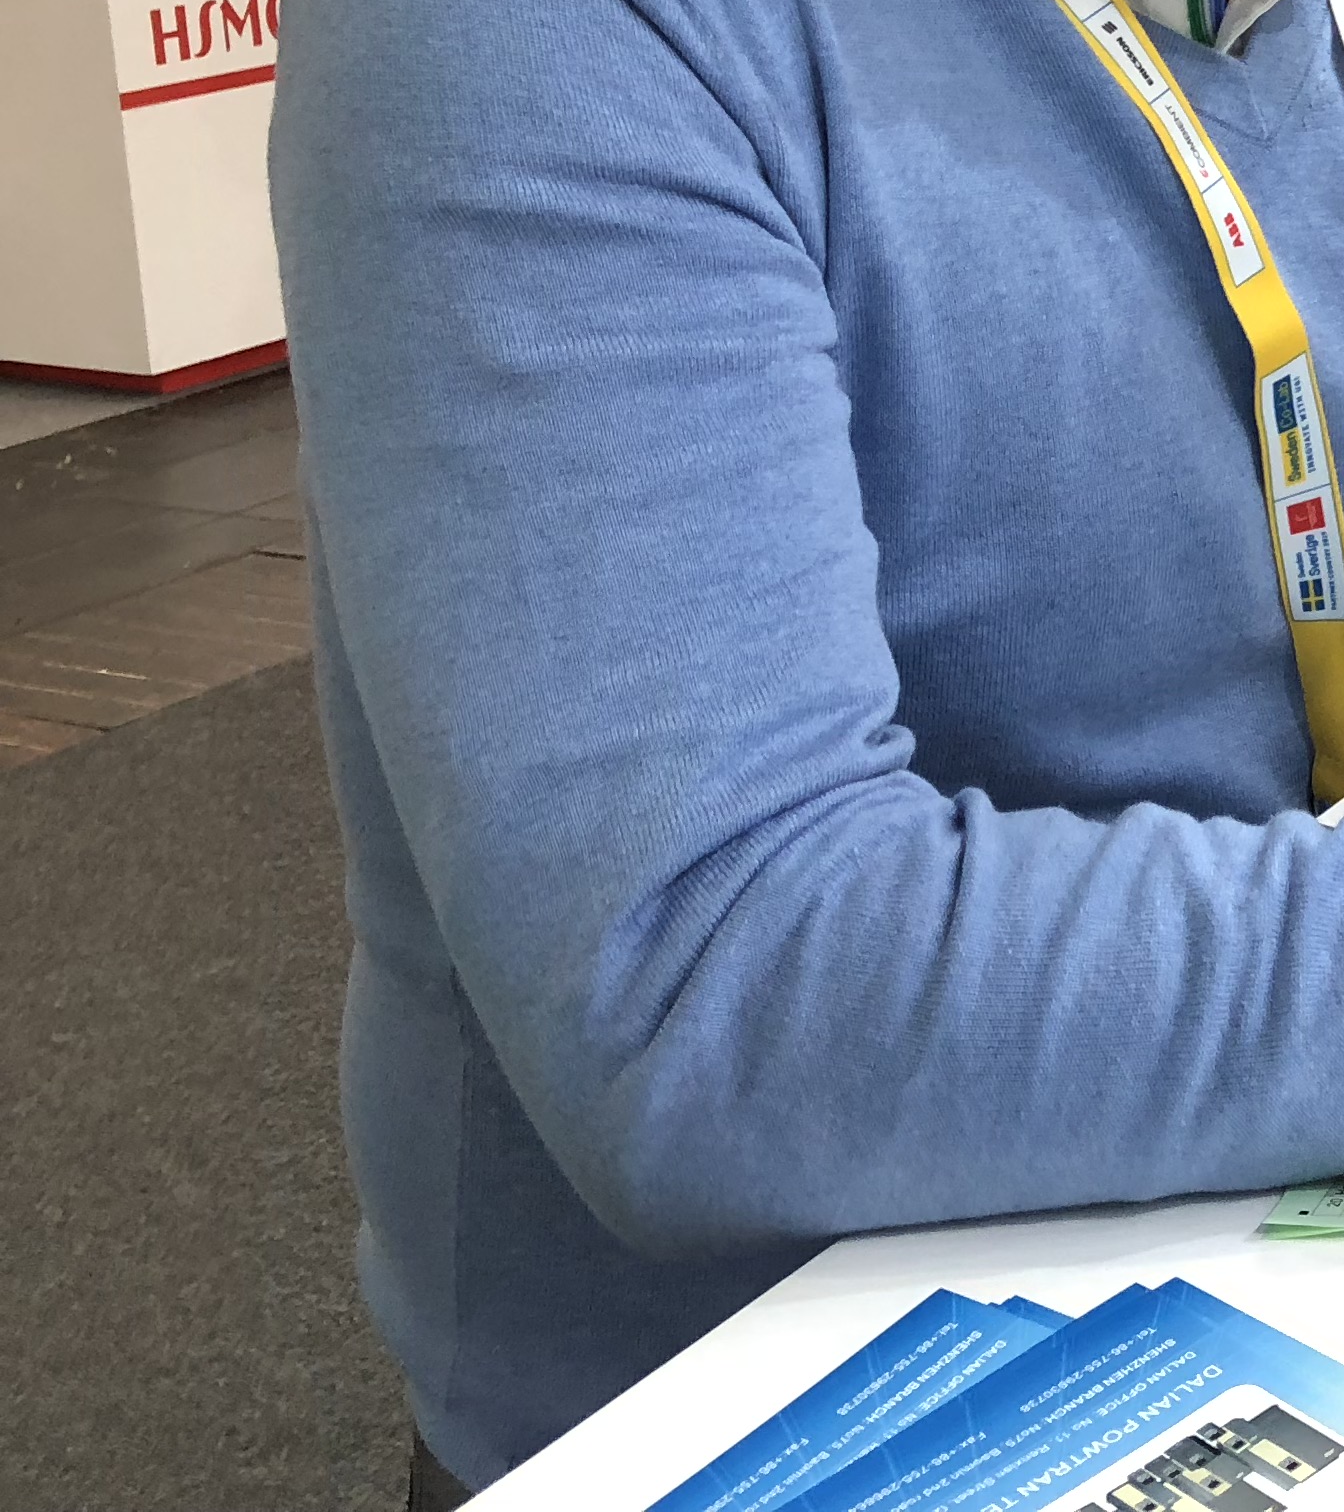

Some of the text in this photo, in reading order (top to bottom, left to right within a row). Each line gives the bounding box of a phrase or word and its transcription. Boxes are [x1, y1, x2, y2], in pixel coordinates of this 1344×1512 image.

[1116, 37, 1153, 85] ERICSSON
[1165, 105, 1205, 168] COMBIENT
[1224, 212, 1244, 247] ABB
[1275, 381, 1301, 482] Sweden Co-Lab
[1296, 395, 1307, 422] WITH
[1301, 424, 1315, 473] INNOVATE
[1305, 534, 1320, 576] Sverige
[917, 1331, 981, 1382] SHENZHEN
[962, 1340, 1006, 1375] DALIAN
[1103, 1339, 1175, 1386] SHENZHEN
[1146, 1351, 1196, 1384] DALIAN
[1017, 1365, 1222, 1495] DALIAN POWTRAN
